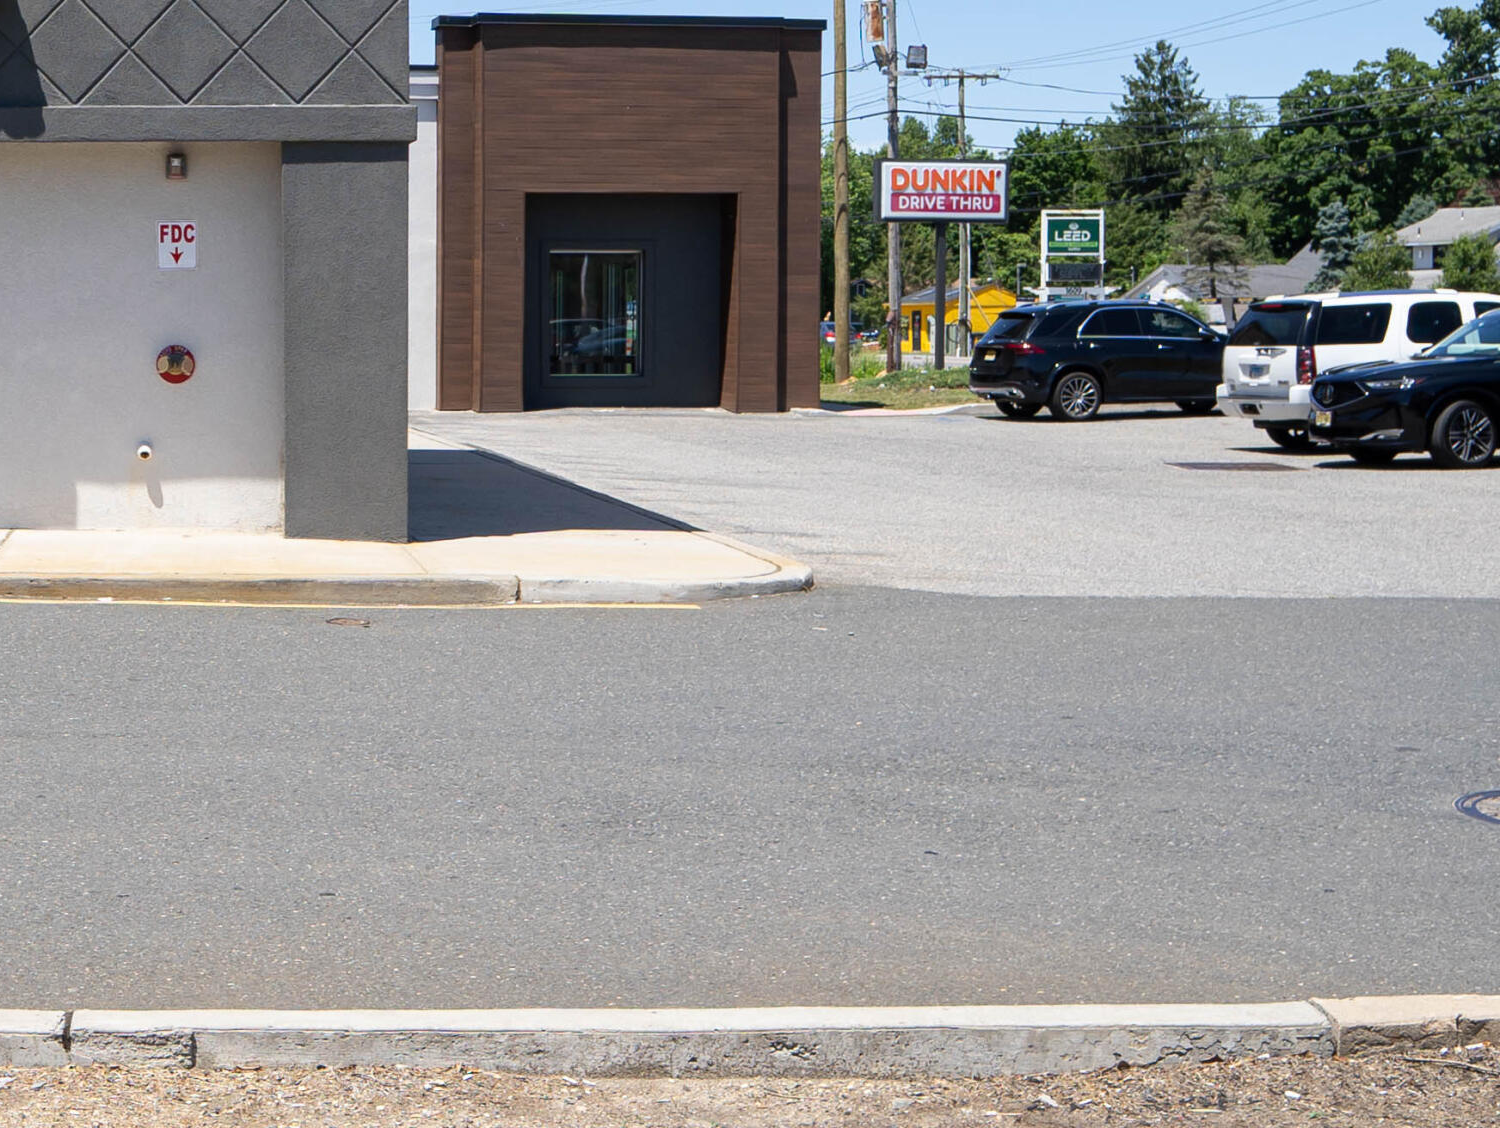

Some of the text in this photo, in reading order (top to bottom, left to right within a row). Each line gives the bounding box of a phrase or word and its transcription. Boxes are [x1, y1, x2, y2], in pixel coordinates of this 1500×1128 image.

[891, 168, 1001, 192] DUNKIN'
[898, 195, 993, 210] DRIVE THRU
[159, 224, 196, 244] FDC
[1054, 230, 1092, 242] LEED
